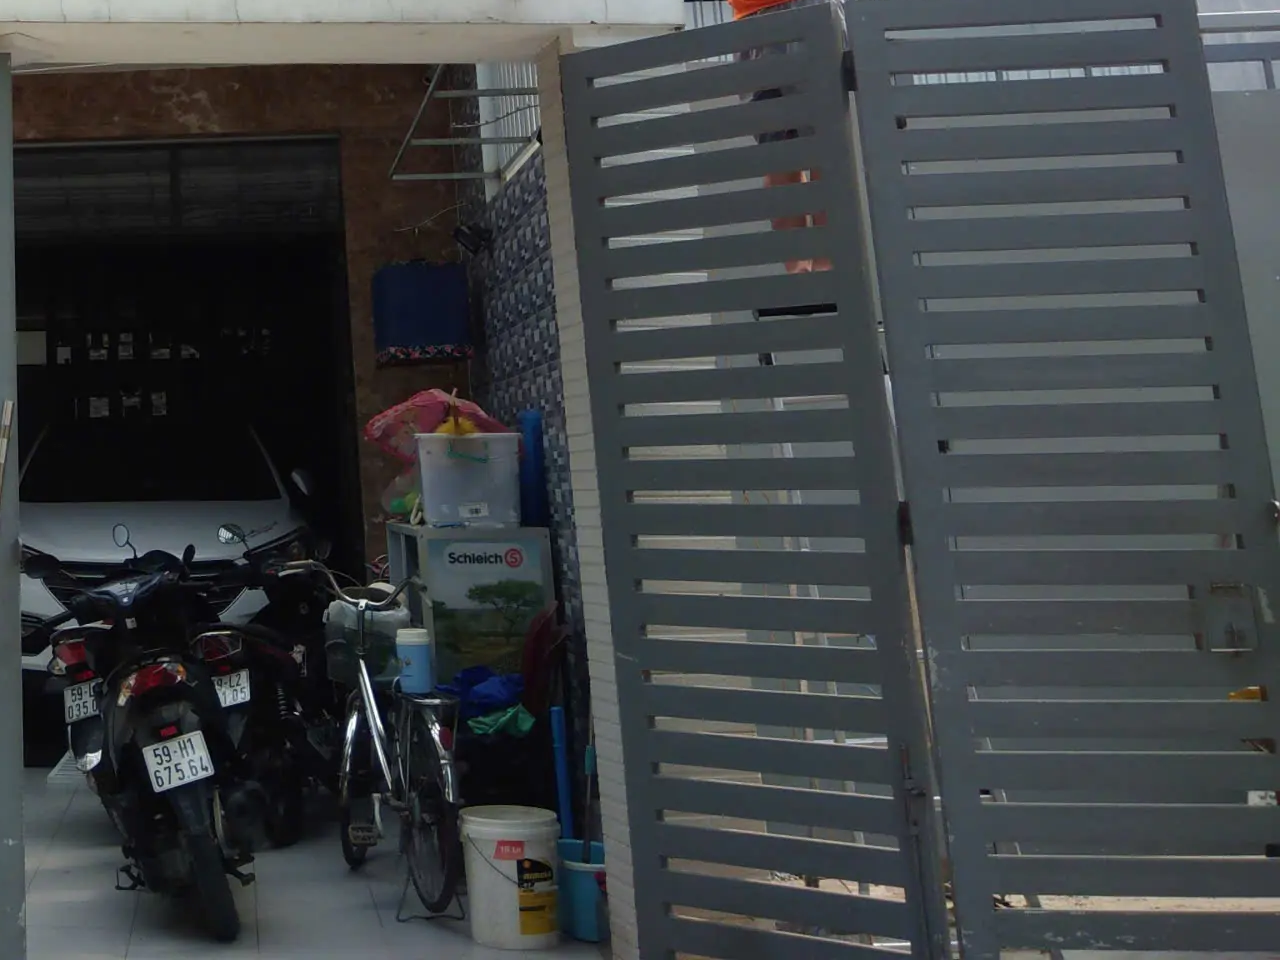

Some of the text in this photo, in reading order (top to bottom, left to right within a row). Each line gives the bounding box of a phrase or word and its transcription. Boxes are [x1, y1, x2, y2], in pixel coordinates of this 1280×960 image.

[448, 552, 503, 564] Schleich
[214, 674, 241, 691] 9-L2
[153, 738, 196, 766] 59-H1
[154, 755, 209, 788] 675.64
